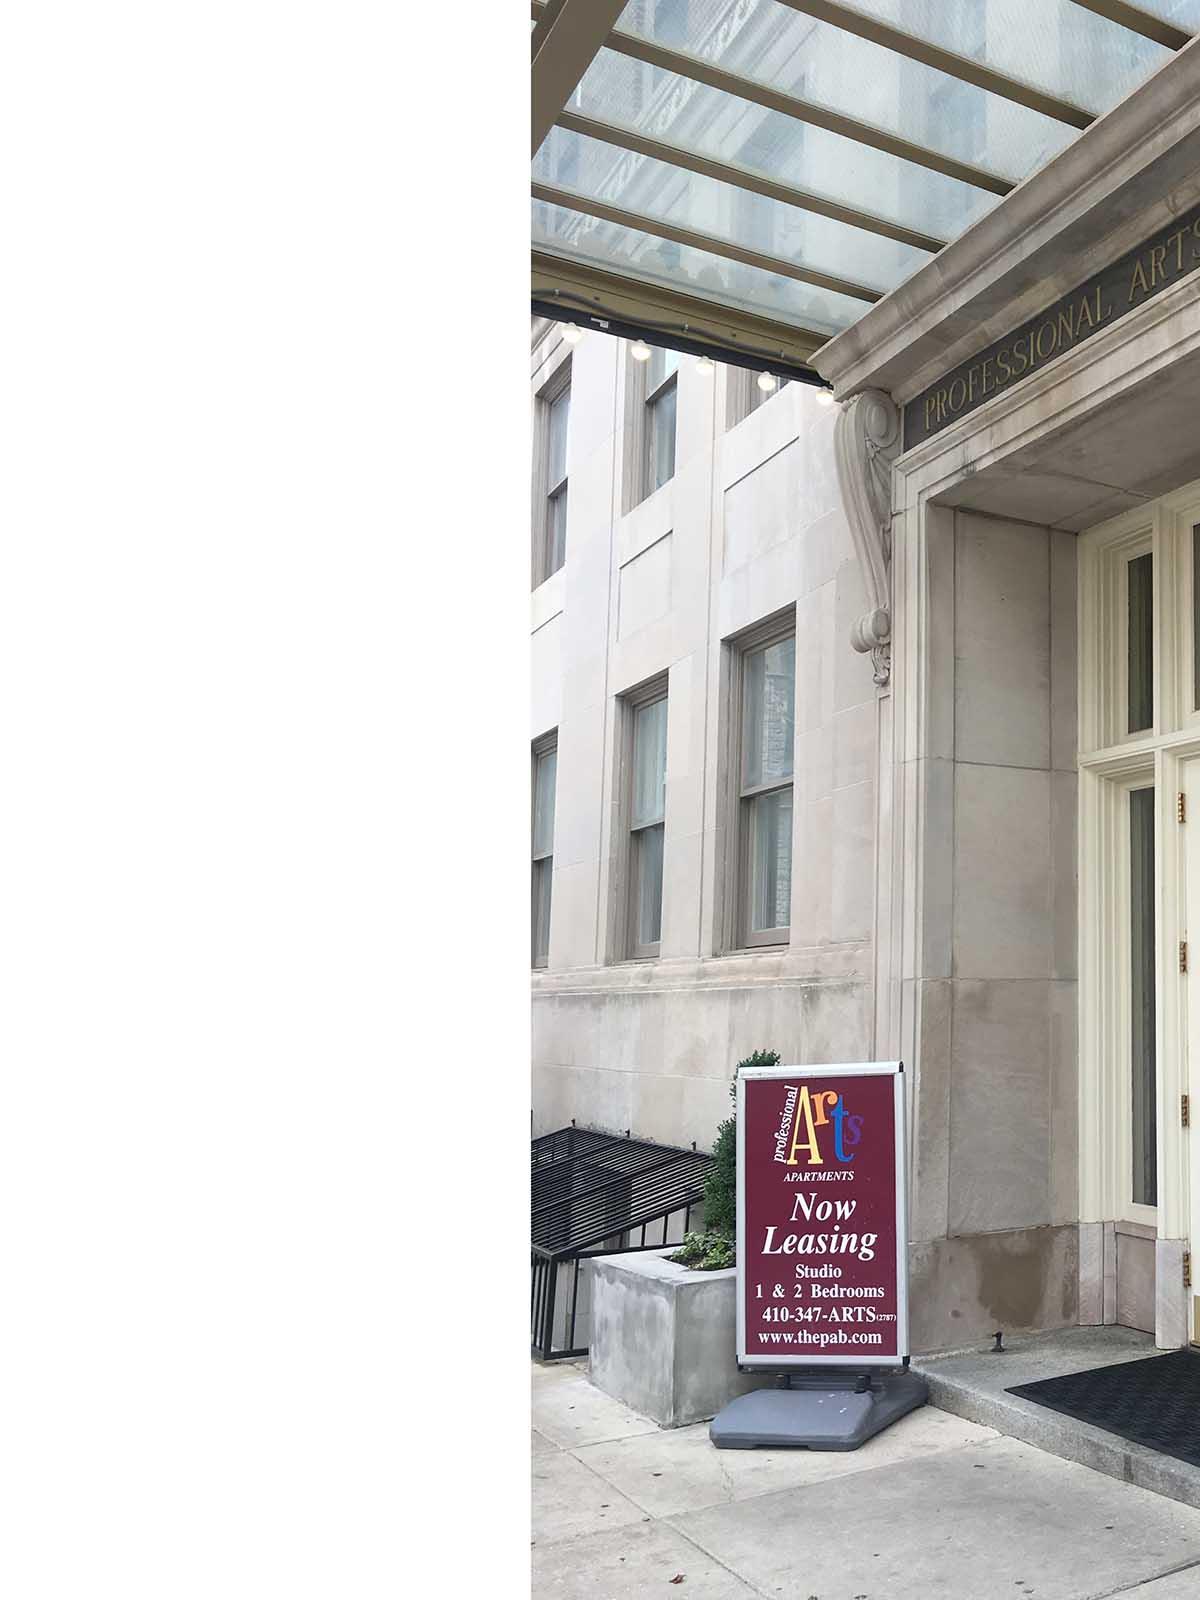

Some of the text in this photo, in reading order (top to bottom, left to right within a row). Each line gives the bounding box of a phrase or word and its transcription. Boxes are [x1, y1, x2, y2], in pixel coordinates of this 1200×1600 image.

[925, 286, 1112, 430] PROFESSIONAL
[773, 1085, 799, 1165] professional
[786, 1085, 865, 1165] Arts
[783, 1170, 855, 1182] APARTMENTS
[789, 1192, 857, 1222] Now
[761, 1224, 878, 1261] Leasing
[795, 1263, 842, 1279] Studio
[755, 1283, 885, 1298] 1 & 2 Bedrooms
[758, 1329, 882, 1348] www.thepab.com
